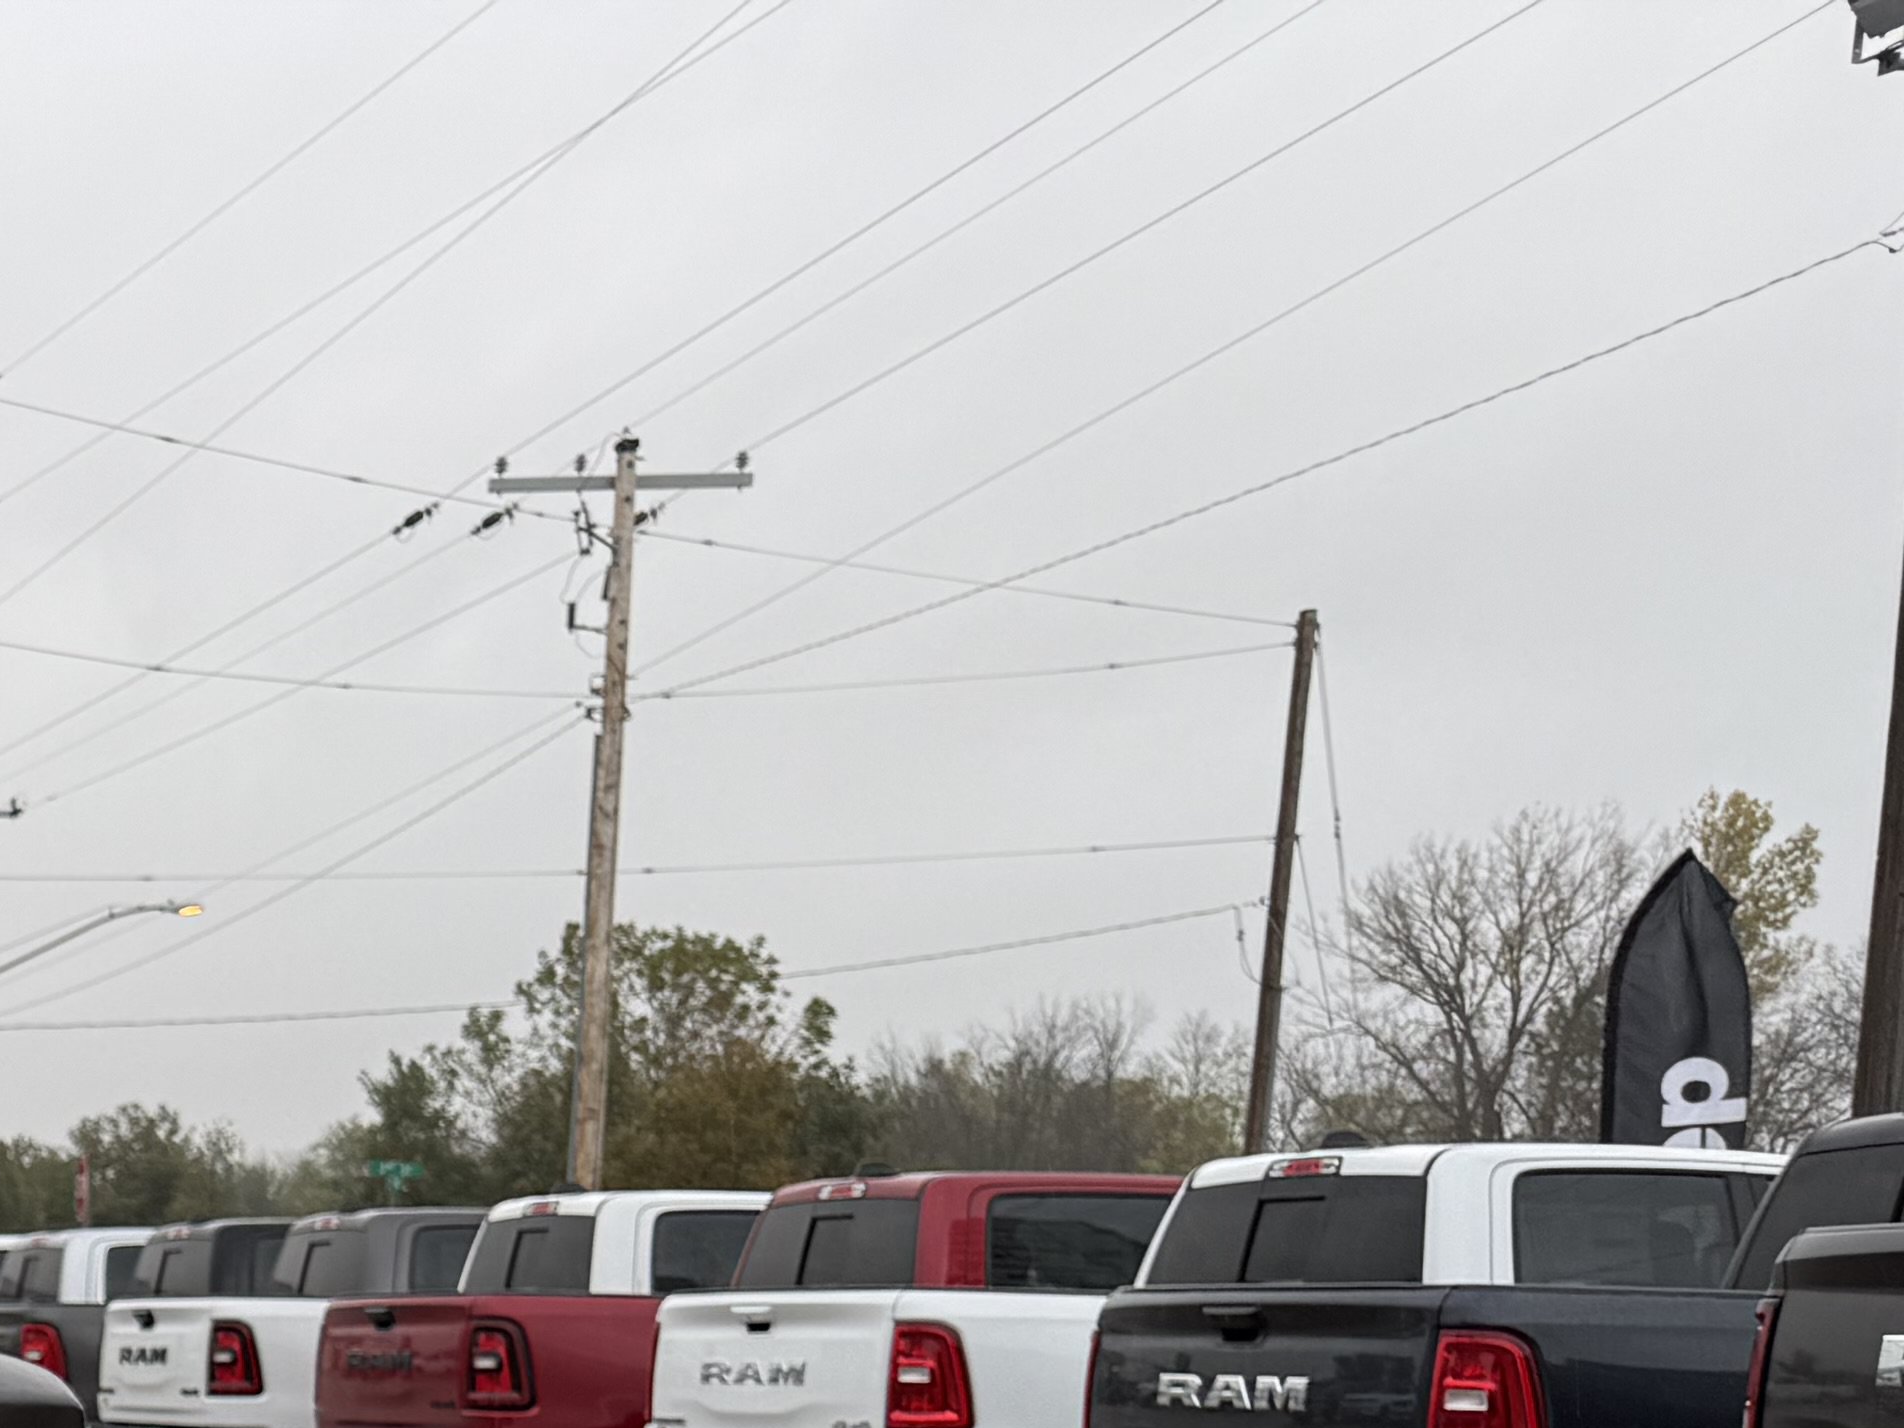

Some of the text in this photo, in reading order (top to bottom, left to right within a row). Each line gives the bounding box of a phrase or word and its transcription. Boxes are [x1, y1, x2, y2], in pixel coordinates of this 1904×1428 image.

[118, 1347, 168, 1365] RAM
[700, 1360, 807, 1386] RAM
[1156, 1372, 1310, 1412] RAM
